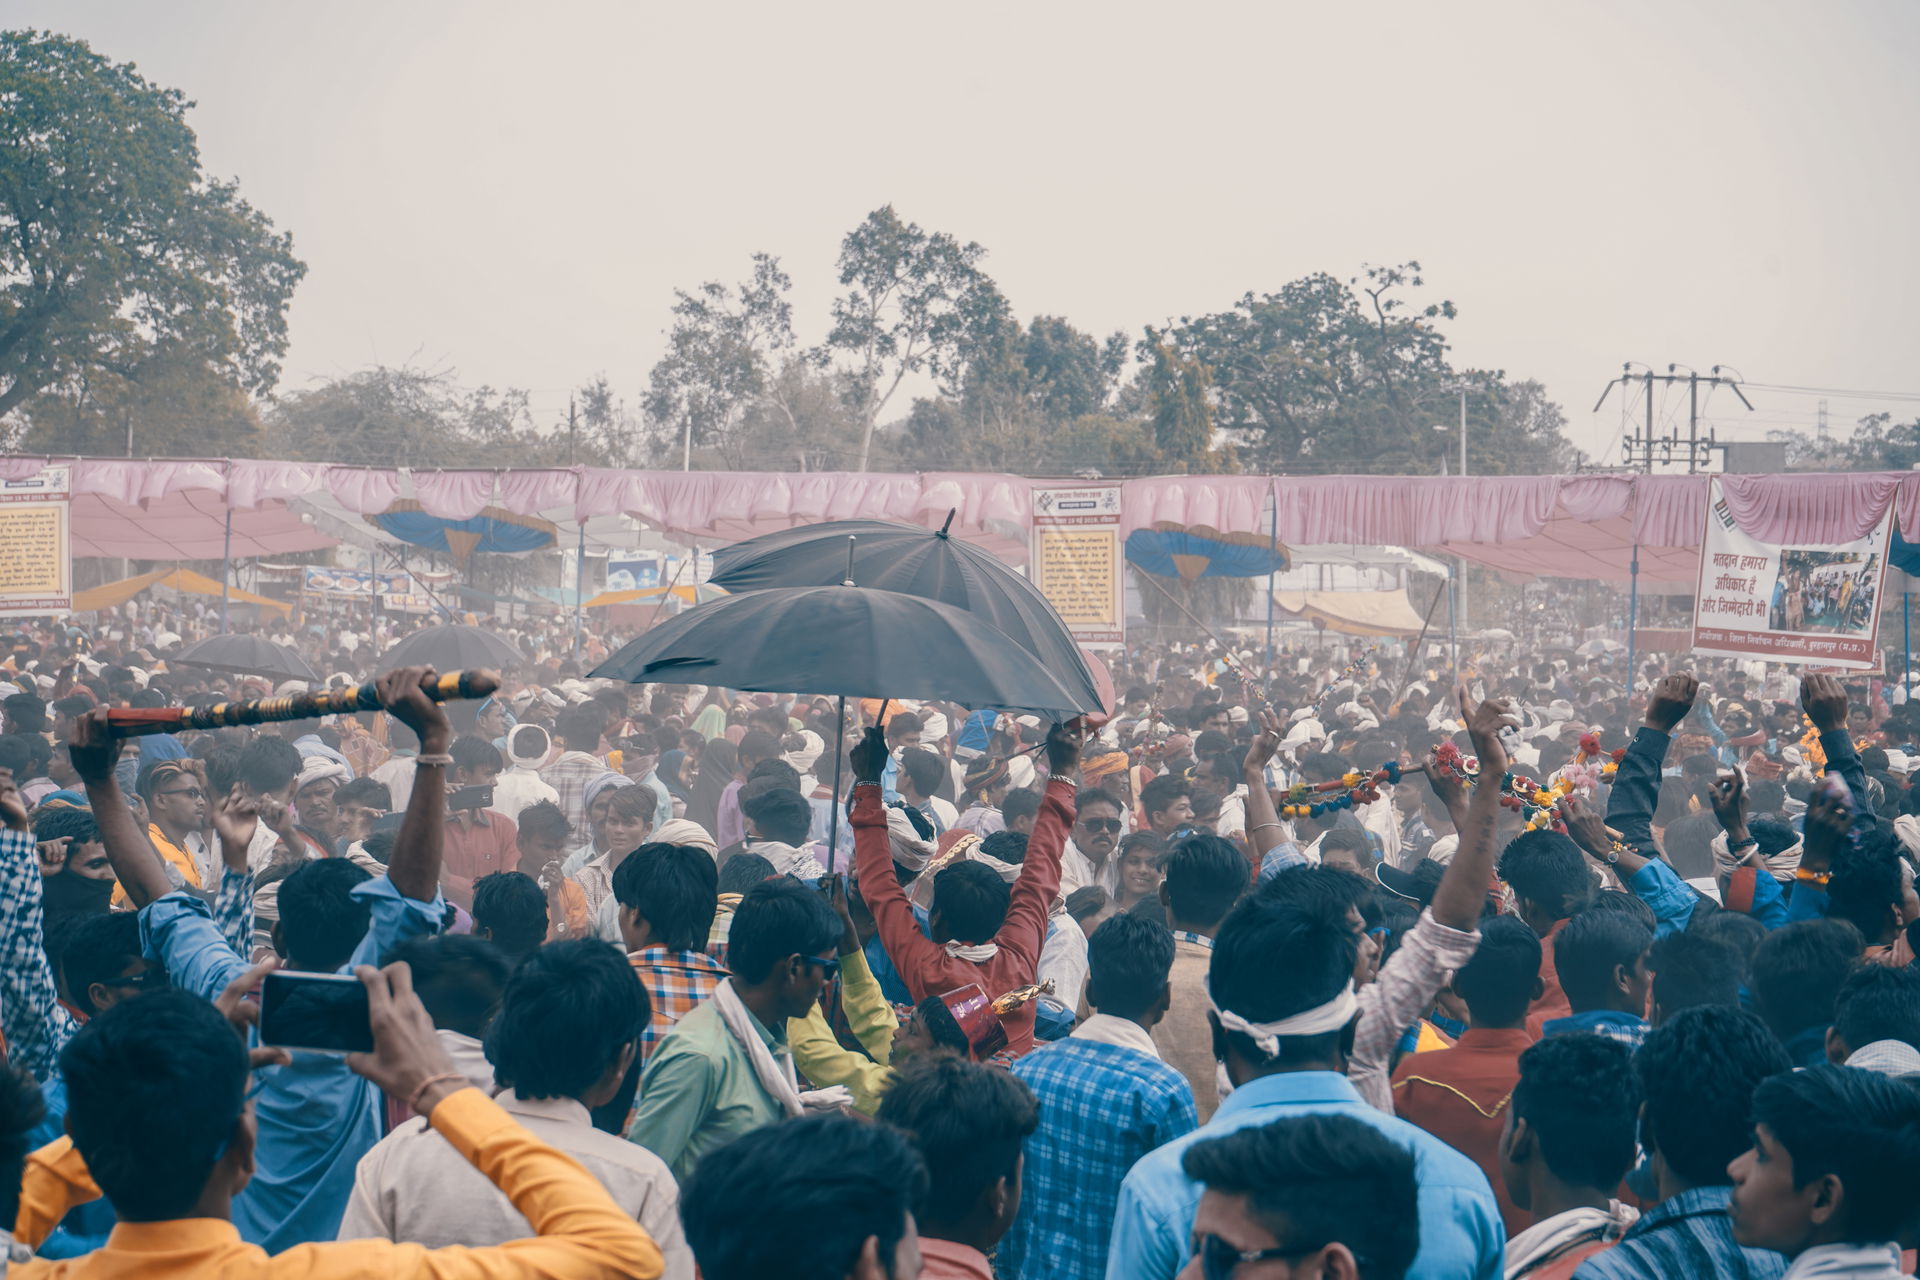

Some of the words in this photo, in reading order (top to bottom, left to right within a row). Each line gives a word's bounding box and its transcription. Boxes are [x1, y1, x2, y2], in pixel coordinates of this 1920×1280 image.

[1713, 553, 1739, 569] मतदान
[1740, 555, 1768, 571] हमारा
[1715, 573, 1747, 592] अधिकार
[1748, 575, 1757, 595] है
[1701, 594, 1716, 613] और
[1718, 596, 1754, 618] जिम्मेदारी
[1756, 600, 1767, 617] भी
